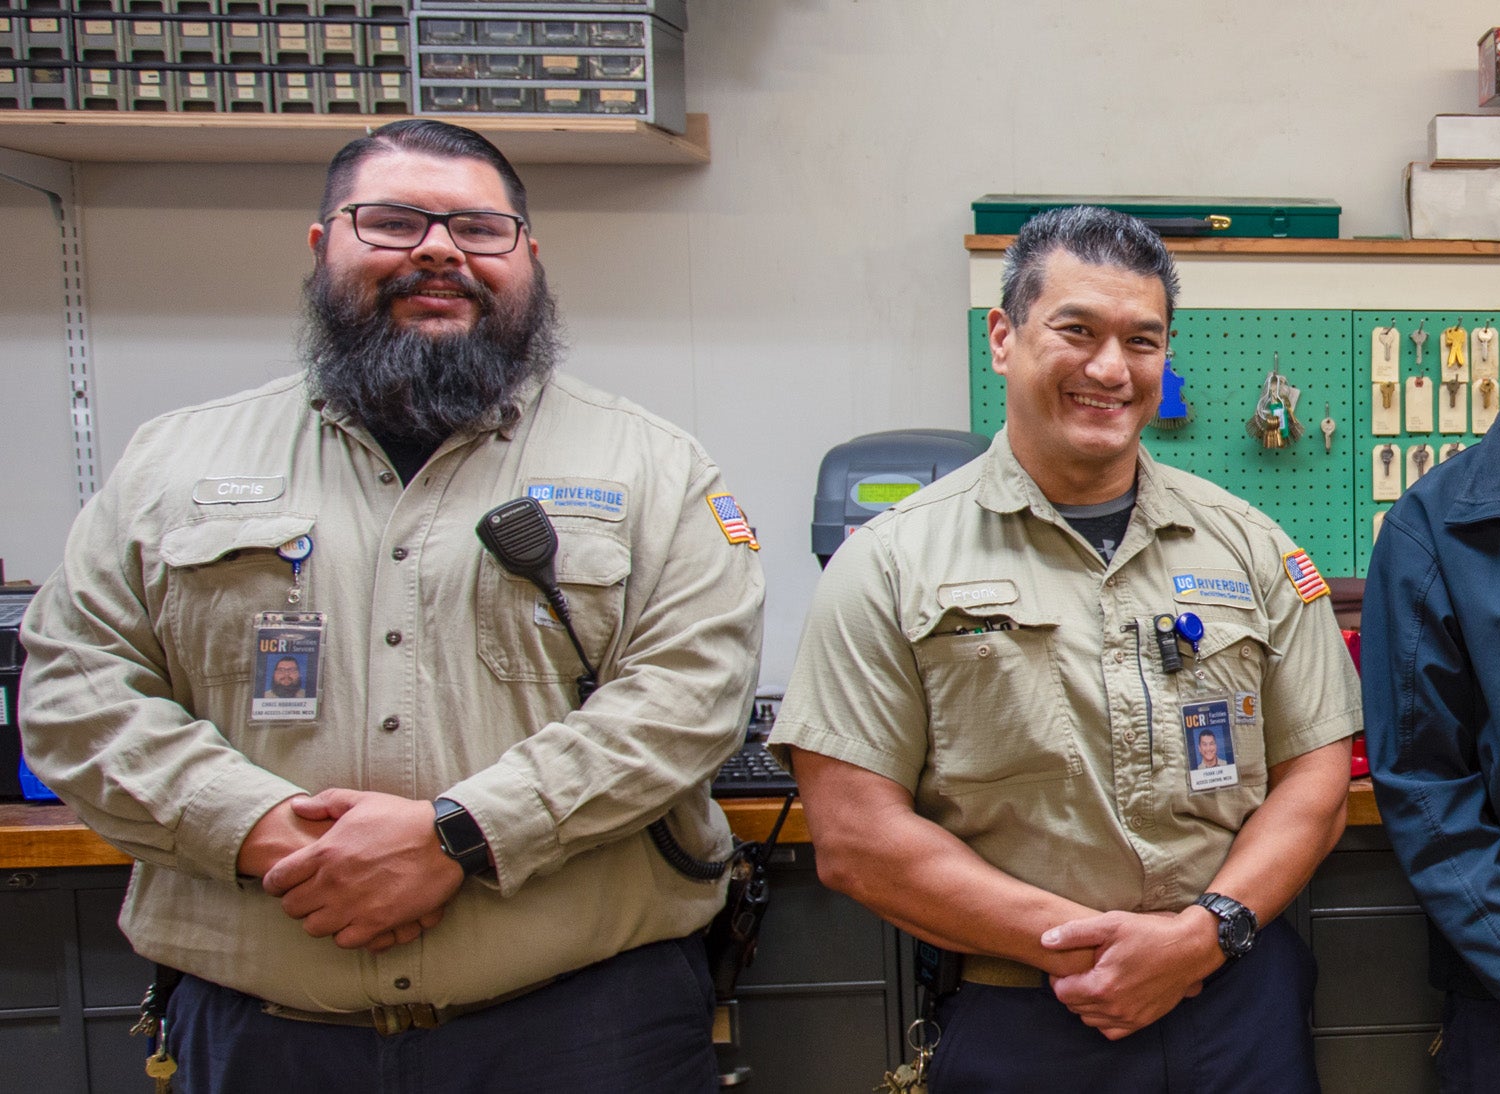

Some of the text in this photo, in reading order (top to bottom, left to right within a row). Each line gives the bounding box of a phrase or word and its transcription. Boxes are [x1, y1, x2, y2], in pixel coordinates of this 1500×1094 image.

[217, 482, 264, 495] Chris
[532, 486, 624, 506] UC RIVERSIDE
[1176, 577, 1252, 595] UC RIVERSIDE
[951, 587, 998, 602] Frank
[260, 640, 287, 653] UCR
[1185, 713, 1207, 728] UCR
